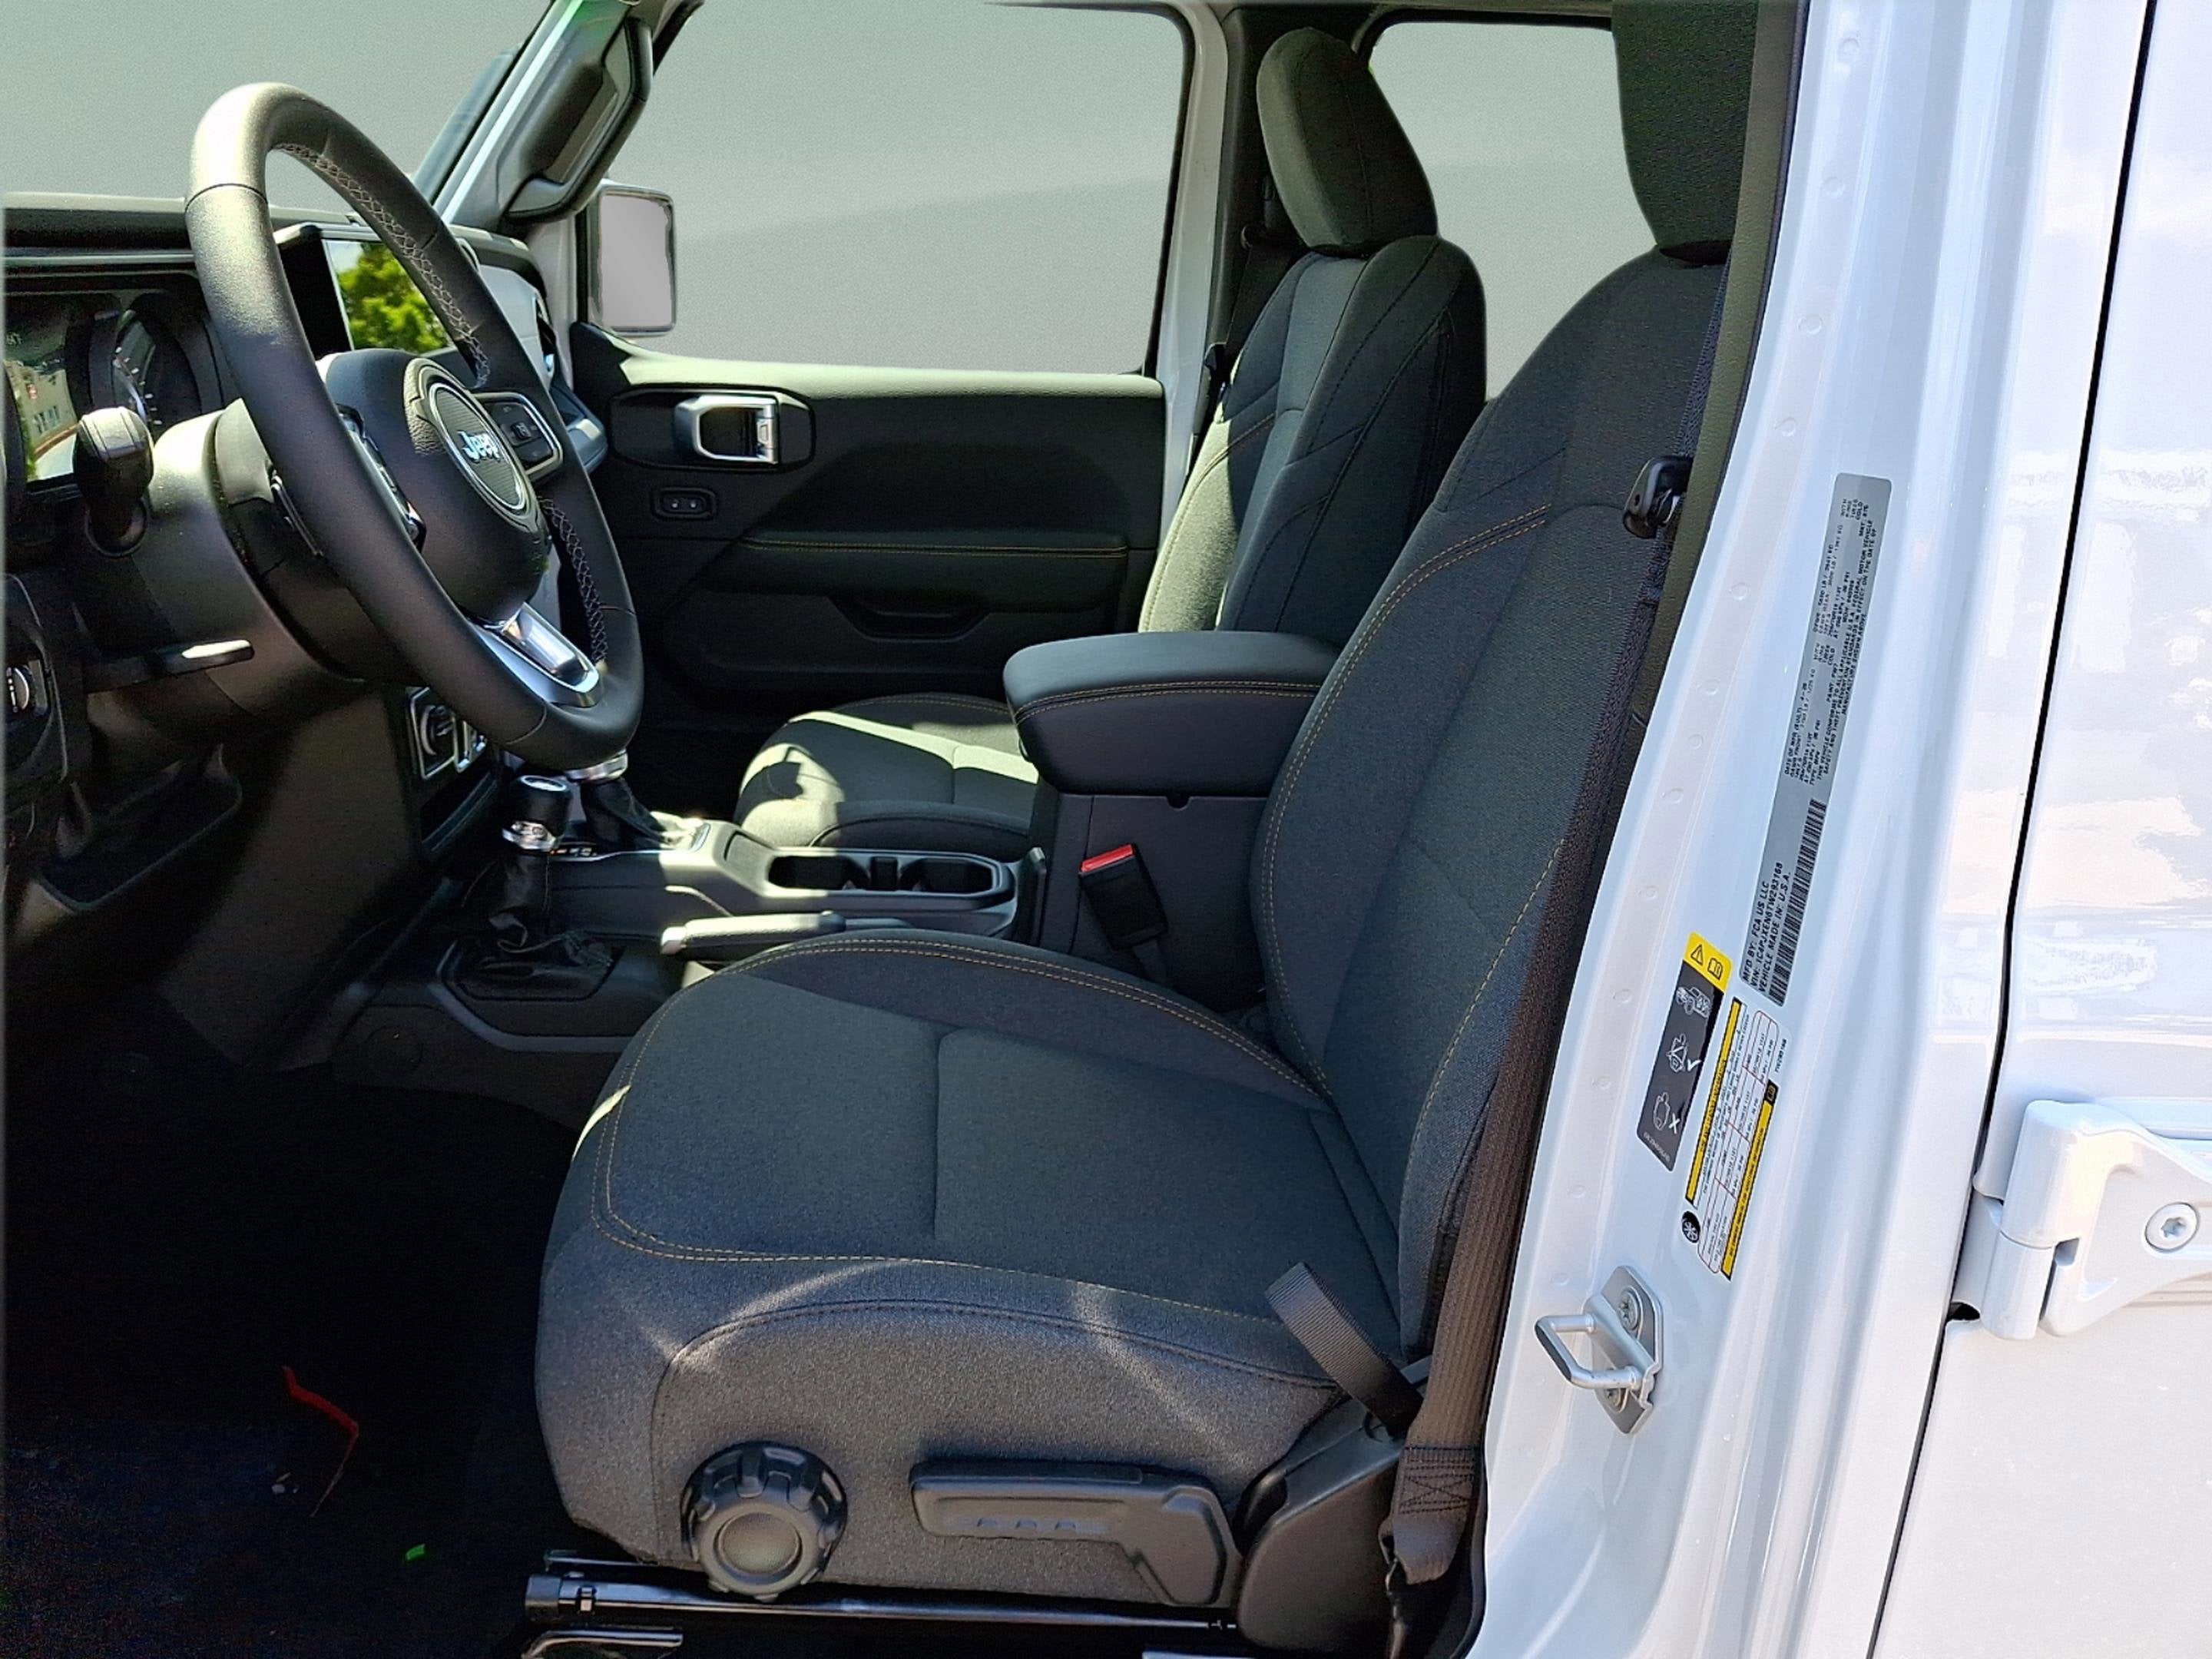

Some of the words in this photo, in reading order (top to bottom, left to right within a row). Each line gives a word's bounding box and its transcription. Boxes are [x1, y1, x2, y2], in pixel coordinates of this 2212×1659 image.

[457, 431, 499, 460] Jeep
[1760, 881, 1769, 899] LLC
[1757, 902, 1764, 916] US
[1752, 918, 1761, 937] FCA
[1759, 953, 1773, 993] VEHICLE
[1768, 922, 1780, 950] MADE
[1751, 967, 1760, 987] VIN:
